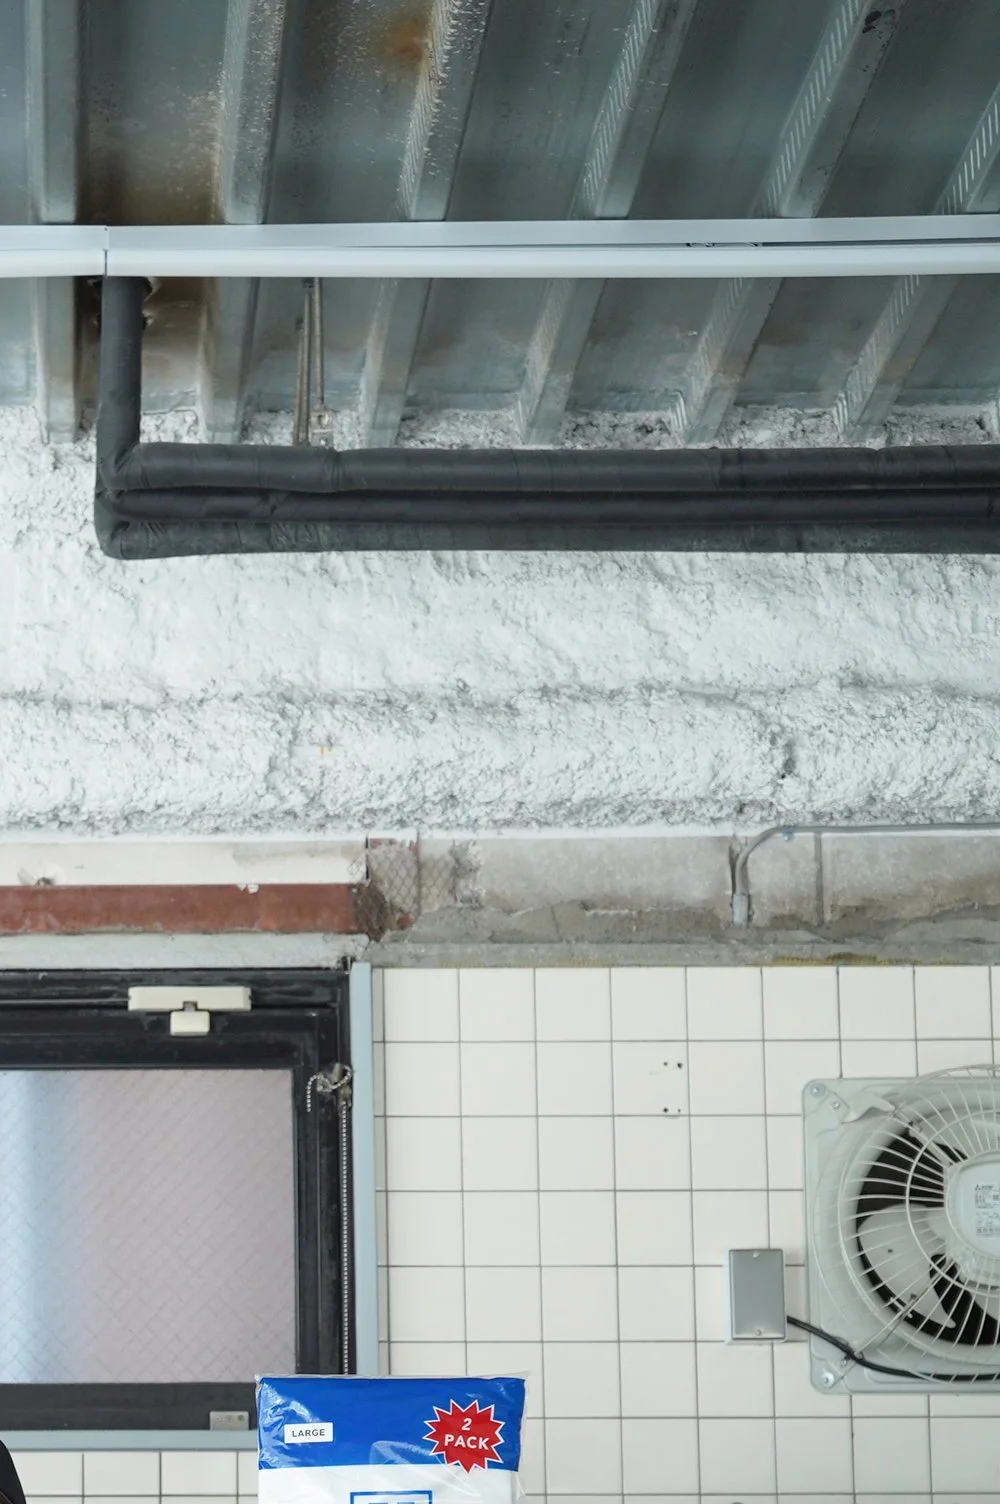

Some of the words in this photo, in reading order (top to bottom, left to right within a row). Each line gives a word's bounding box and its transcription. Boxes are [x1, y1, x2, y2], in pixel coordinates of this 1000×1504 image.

[461, 1417, 472, 1431] 2
[291, 1428, 326, 1438] LARGE
[444, 1434, 490, 1450] PACK
